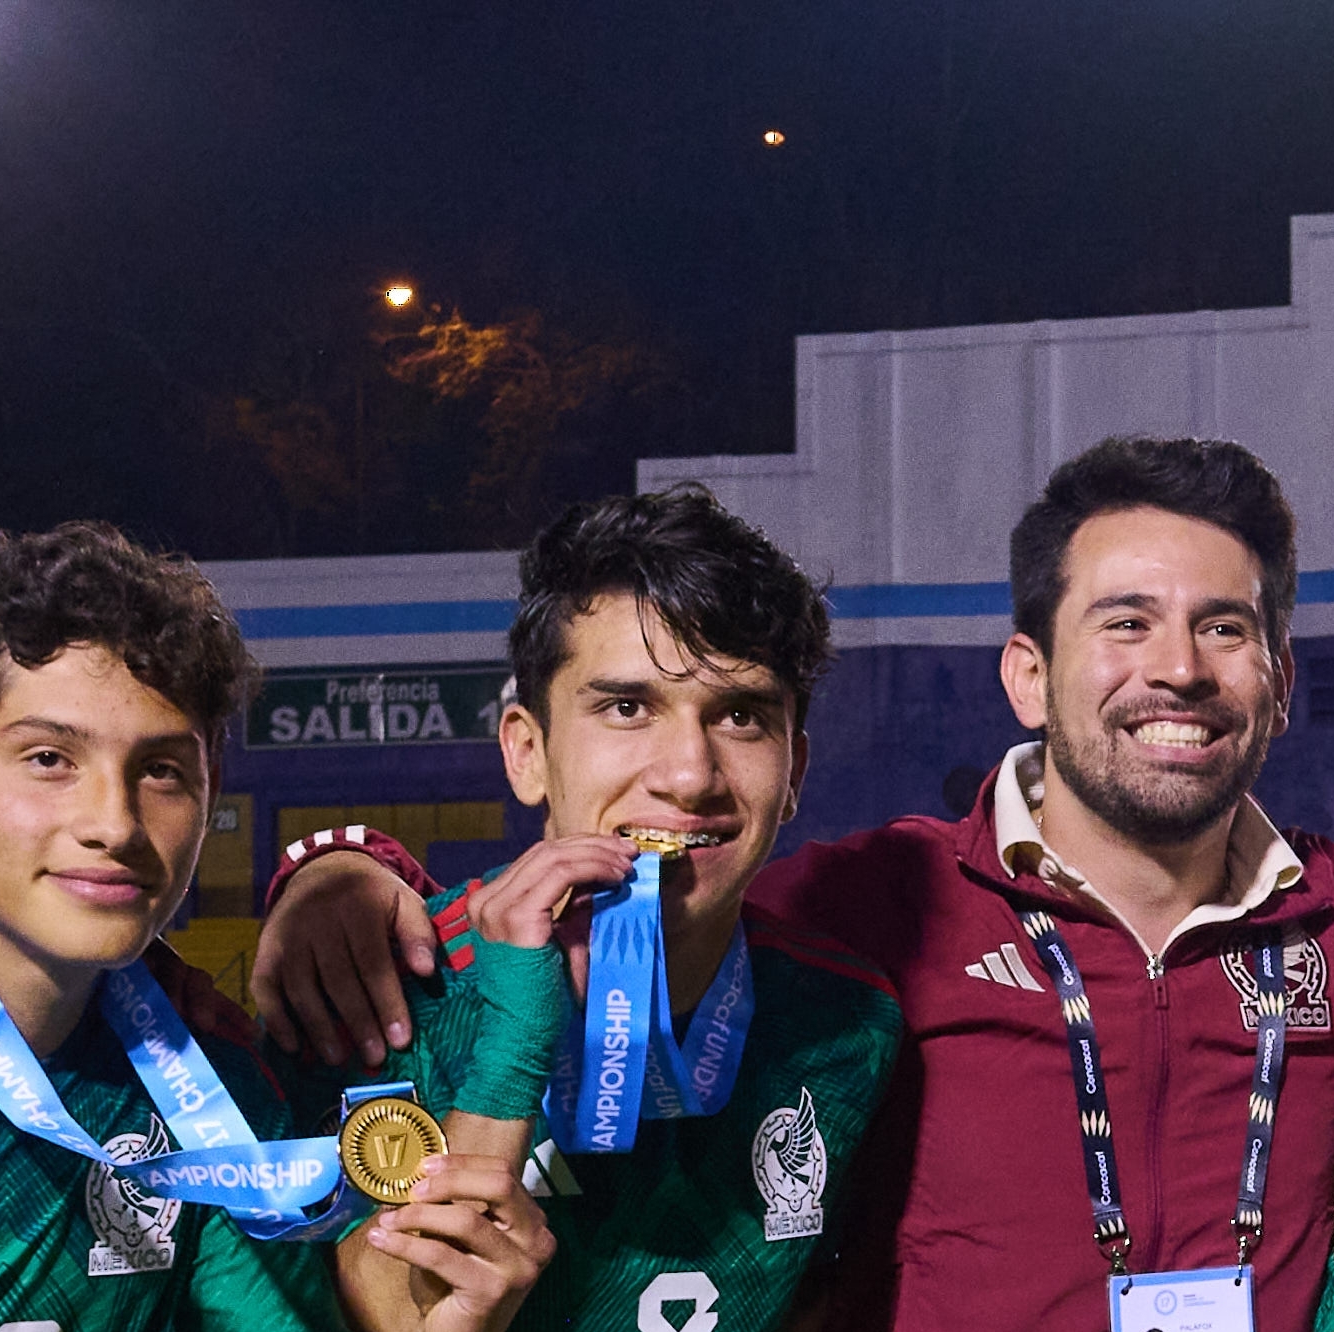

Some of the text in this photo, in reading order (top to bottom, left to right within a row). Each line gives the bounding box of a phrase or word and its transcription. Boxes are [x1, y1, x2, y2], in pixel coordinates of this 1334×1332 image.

[326, 678, 440, 704] Preferencia
[271, 703, 454, 743] SALIDA
[1078, 1039, 1097, 1094] Concacaf
[1261, 1028, 1276, 1084] Concacaf
[141, 1159, 324, 1190] AMPIONSHIP
[373, 1133, 407, 1169] 17
[1246, 1138, 1263, 1192] Concacaf
[1095, 1151, 1111, 1205] Concacaf
